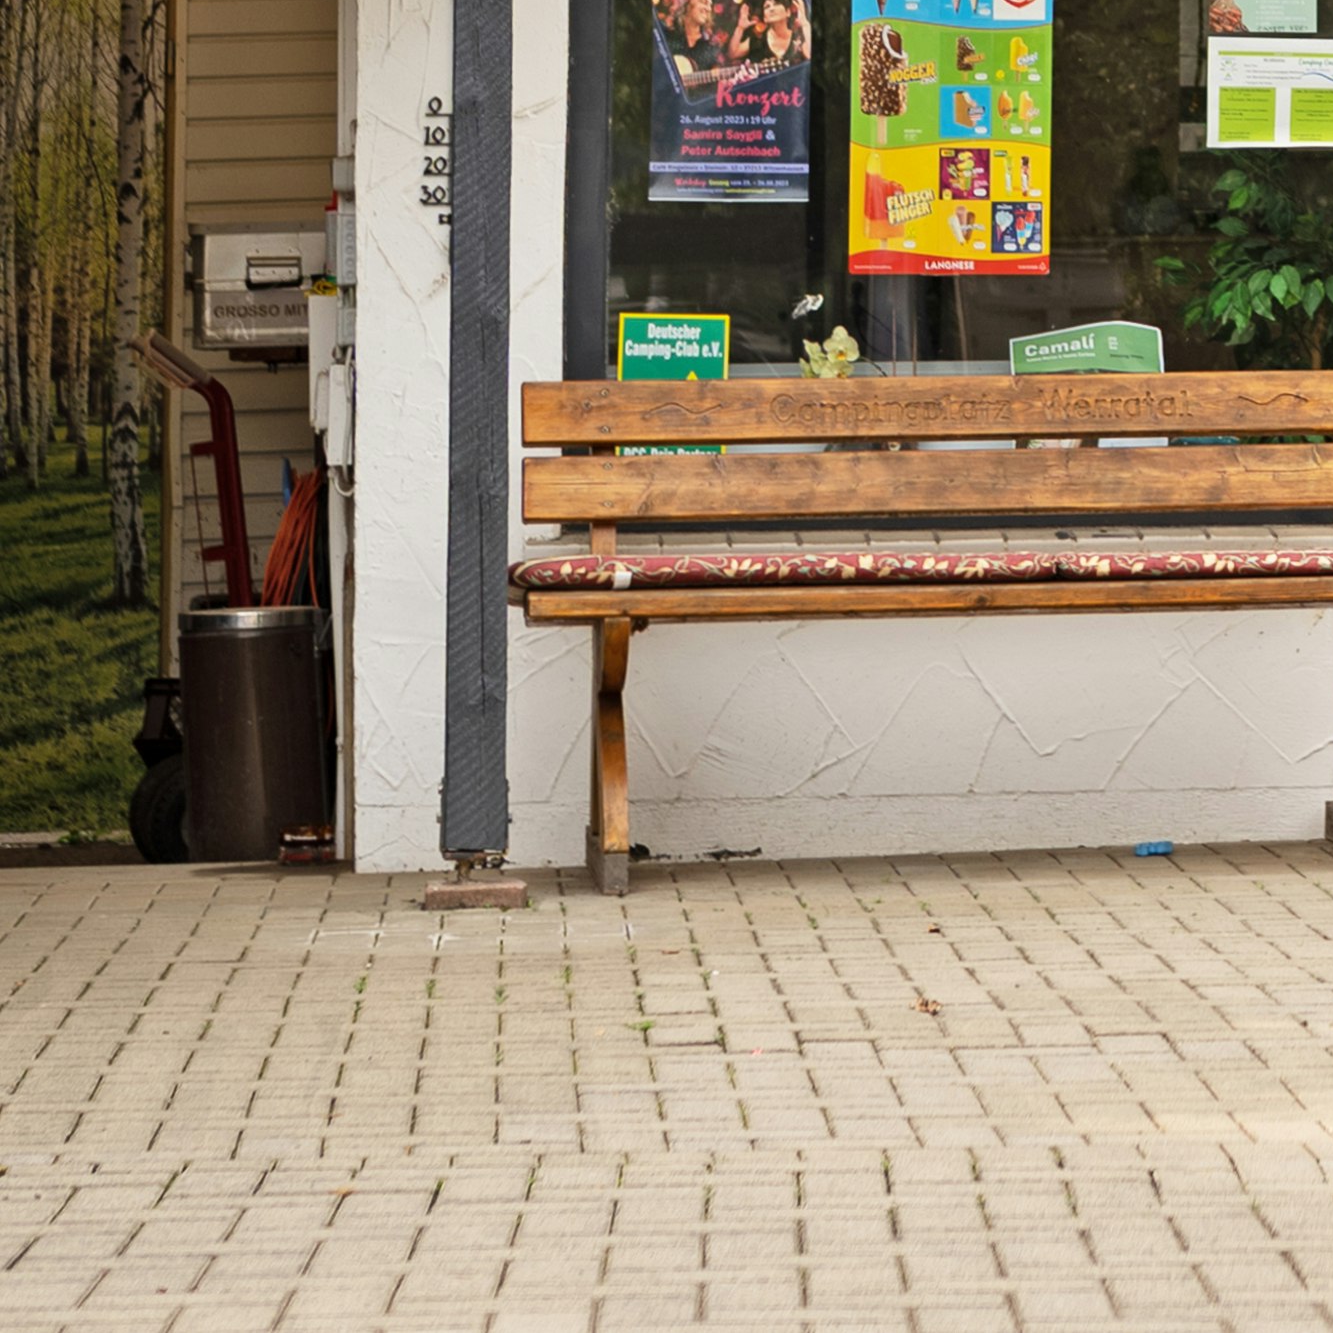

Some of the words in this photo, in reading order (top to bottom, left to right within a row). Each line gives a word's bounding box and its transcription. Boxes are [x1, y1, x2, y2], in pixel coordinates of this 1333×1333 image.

[889, 61, 936, 83] NOGGER
[427, 96, 443, 115] 0
[716, 79, 805, 116] Konzert
[694, 116, 722, 126] August
[724, 116, 744, 125] 2023
[762, 116, 777, 125] Uhr
[424, 126, 446, 146] 10
[683, 129, 722, 140] Samira
[765, 129, 776, 141] &
[681, 145, 712, 156] Peter
[714, 145, 781, 157] Autschbach
[423, 156, 447, 176] 20
[419, 185, 446, 206] 30
[886, 189, 935, 211] FLUTSCH
[888, 202, 933, 226] FINGER
[924, 261, 975, 271] LANGNESE
[213, 303, 280, 318] GROSSO
[647, 322, 701, 340] Deutscher
[625, 339, 700, 360] Camping-Club
[701, 341, 723, 358] e.V.
[770, 393, 1011, 428] Campingplatz
[1038, 388, 1193, 419] Werratal
